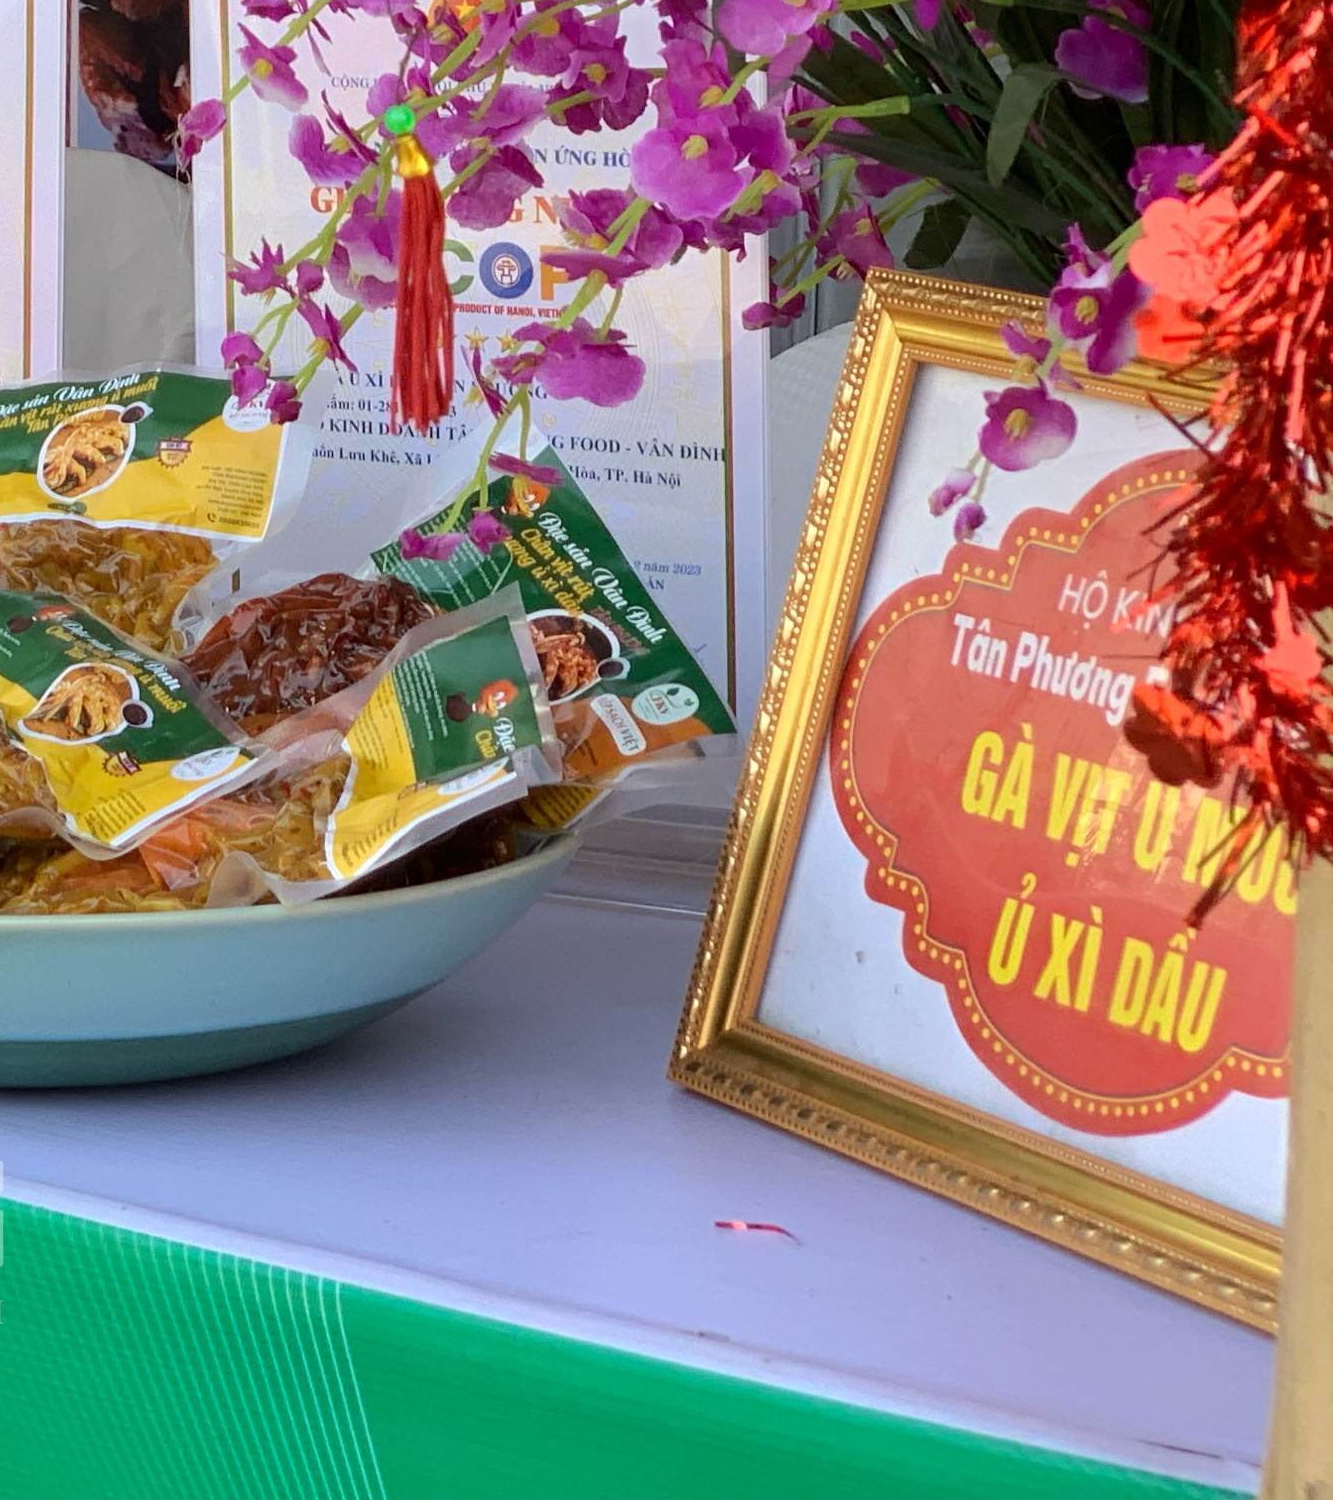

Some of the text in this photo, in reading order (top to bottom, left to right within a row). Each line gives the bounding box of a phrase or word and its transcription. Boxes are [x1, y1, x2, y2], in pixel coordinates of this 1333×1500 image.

[554, 143, 598, 167] ỨNG
[329, 418, 725, 462] KINH FOOD VÂN ĐÌNH
[339, 448, 367, 462] Lưu
[604, 469, 629, 482] TP.
[633, 468, 653, 484] Hà
[657, 470, 681, 488] Nội
[673, 564, 702, 576] 2023
[1059, 570, 1108, 629] HỘ
[952, 613, 1135, 727] Tân Phương
[961, 722, 1035, 832] GÀ
[1045, 751, 1132, 870] VỊT
[987, 872, 1228, 1055] Ủ XÌ DẦU
